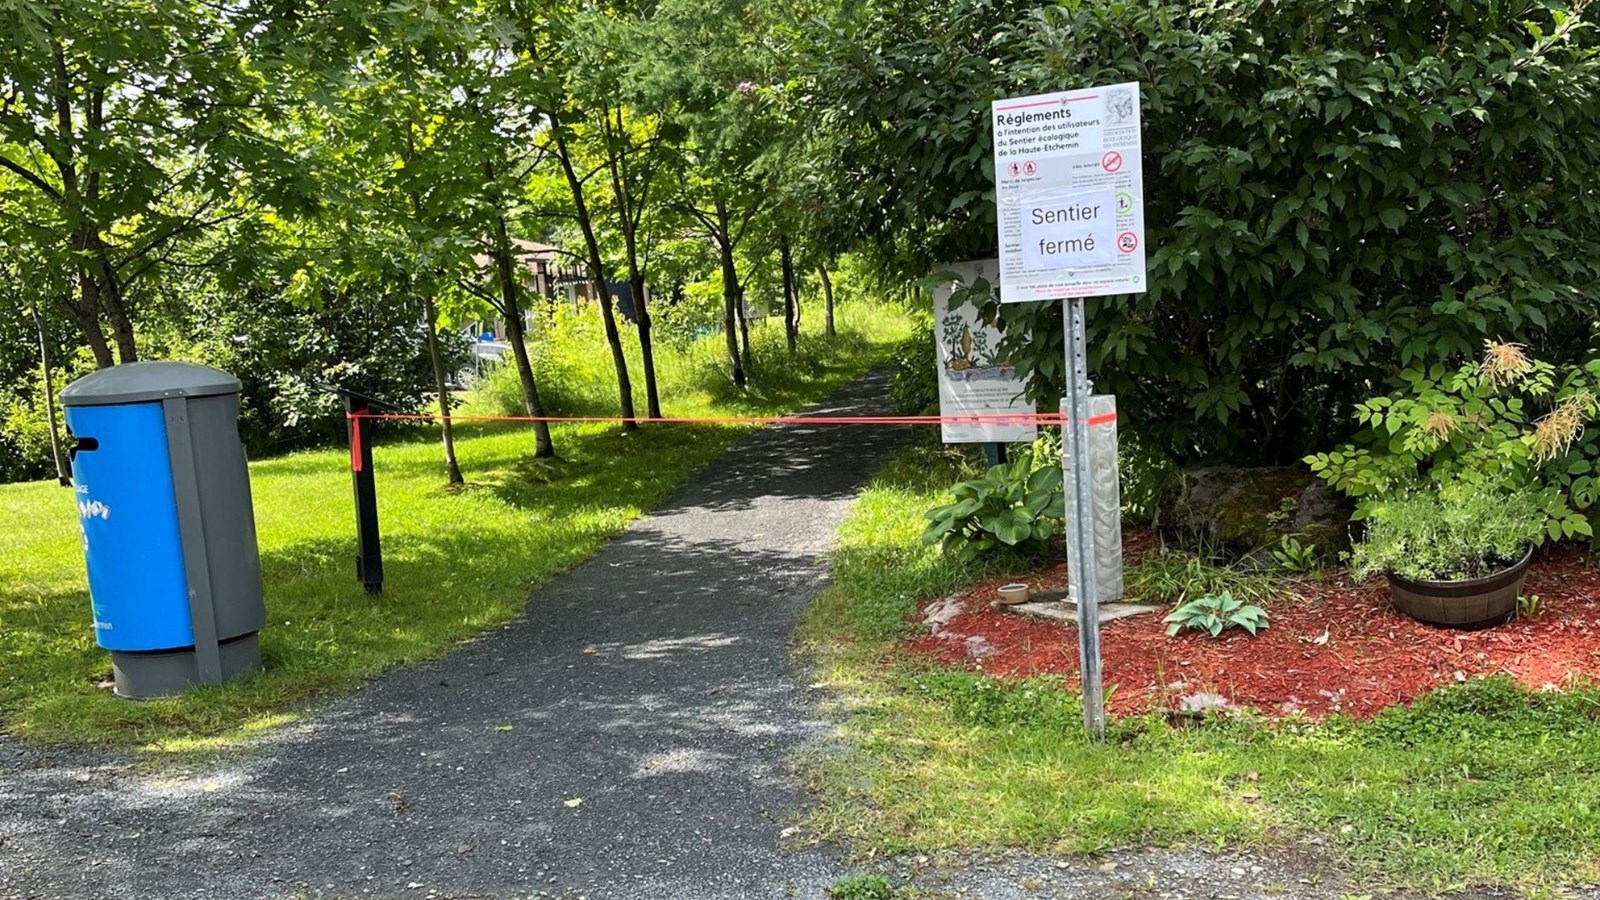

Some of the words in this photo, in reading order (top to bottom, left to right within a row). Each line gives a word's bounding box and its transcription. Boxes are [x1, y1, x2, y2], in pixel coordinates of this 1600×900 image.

[1004, 127, 1041, 136] l'intention
[1042, 124, 1056, 132] des
[1057, 119, 1100, 130] utilisateurs
[997, 139, 1007, 147] du
[1009, 137, 1036, 146] Sentier
[1038, 132, 1079, 142] écologique
[998, 149, 1008, 157] de
[1018, 142, 1079, 154] Haute-Etchemin
[1032, 203, 1100, 225] Sentier
[1039, 233, 1095, 255] fermé
